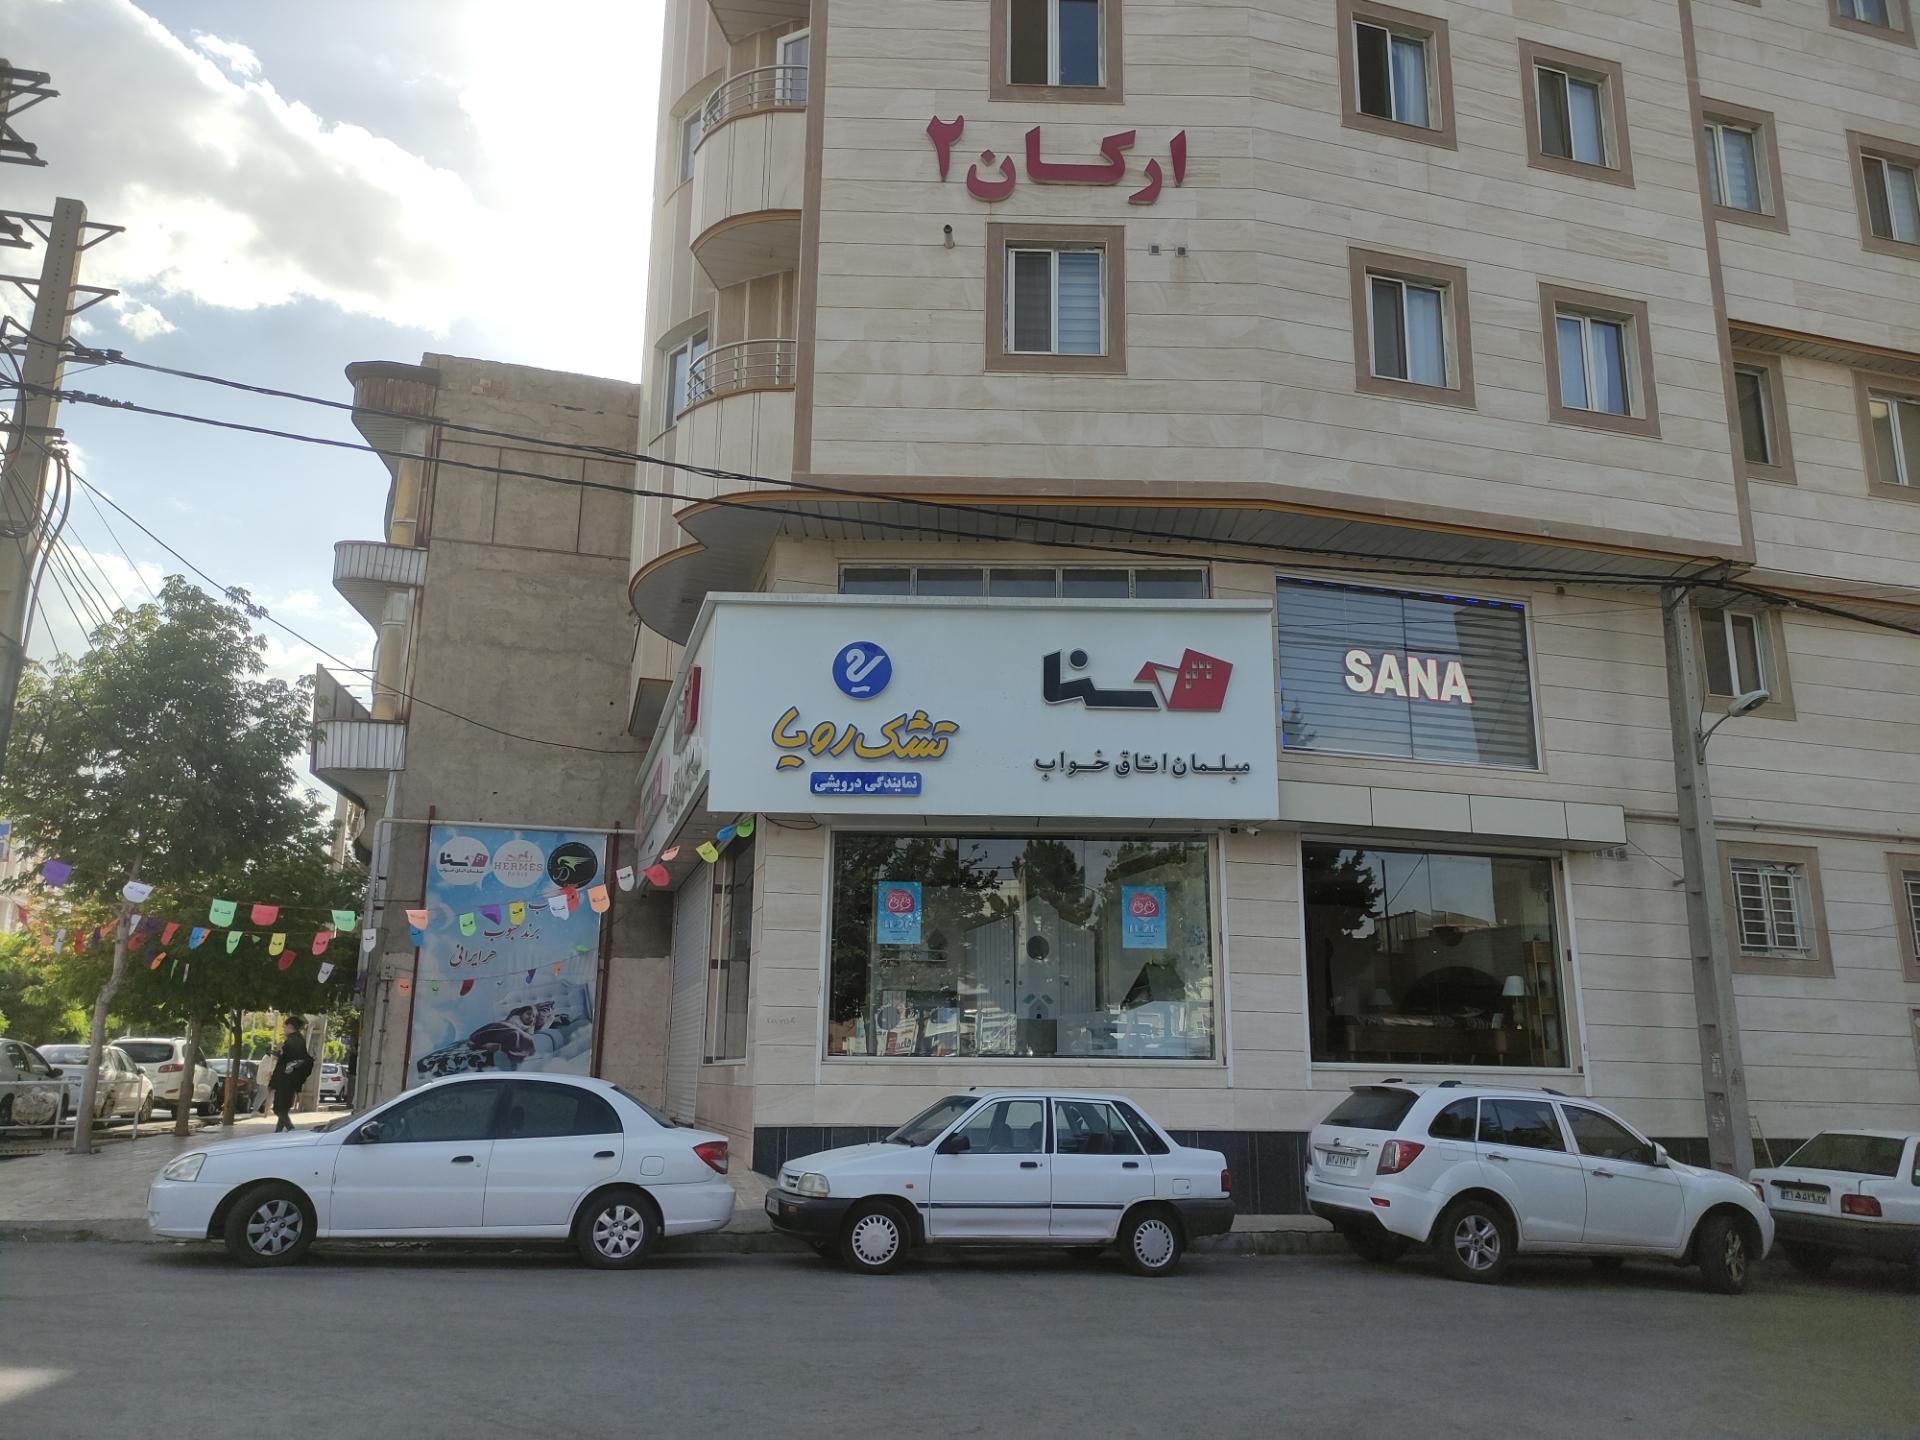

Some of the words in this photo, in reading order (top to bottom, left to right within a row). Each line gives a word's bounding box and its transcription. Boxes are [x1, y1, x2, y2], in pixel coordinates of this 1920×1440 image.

[966, 125, 1187, 206] ارکان
[1344, 648, 1473, 704] SANA
[853, 708, 961, 761] تشک
[1034, 748, 1110, 783] خواب
[1114, 749, 1168, 779] اتاق
[1171, 752, 1252, 785] مبلمان
[814, 774, 862, 793] درویشی
[864, 775, 918, 794] نمایندگی
[494, 862, 544, 872] HERMES
[520, 923, 541, 940] برند
